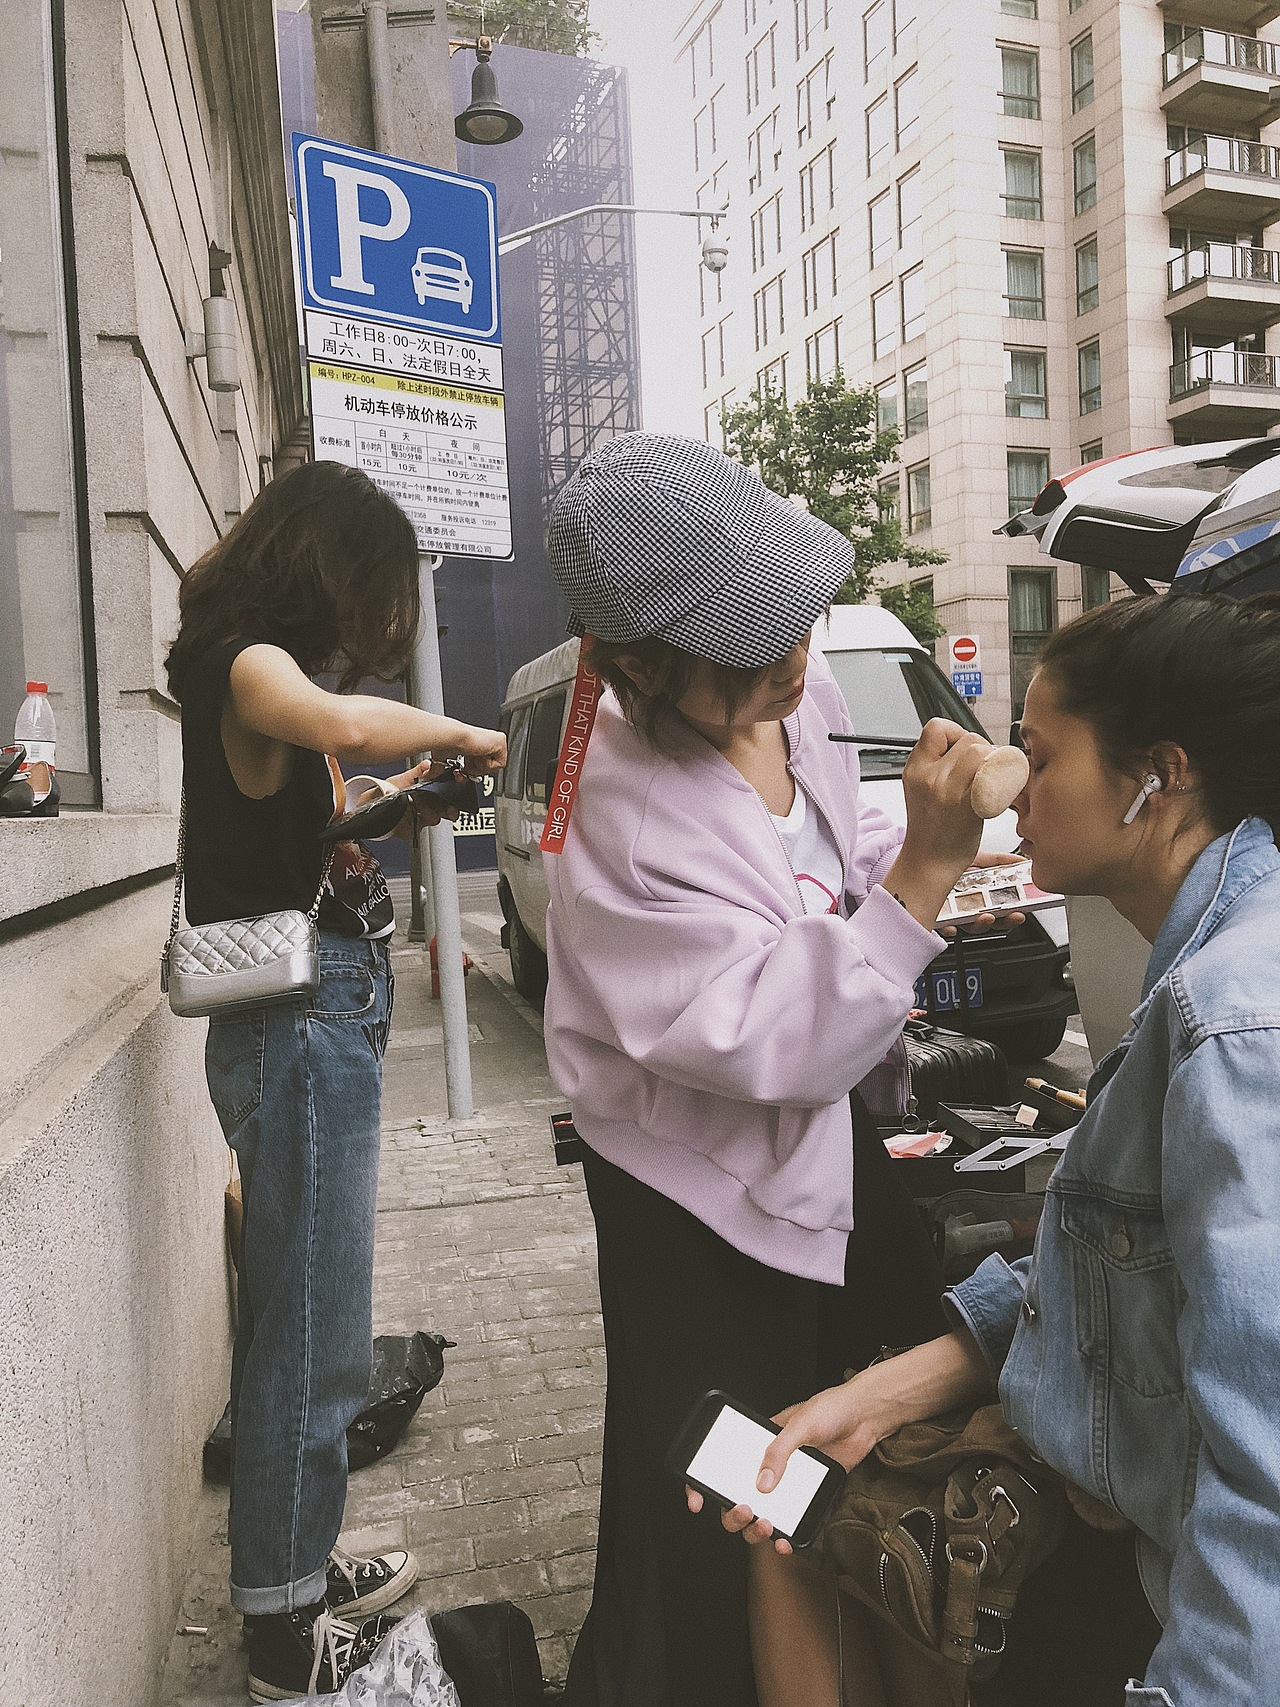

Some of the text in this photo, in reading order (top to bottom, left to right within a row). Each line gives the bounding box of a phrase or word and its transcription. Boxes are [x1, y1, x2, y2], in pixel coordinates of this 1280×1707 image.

[322, 160, 411, 296] P
[322, 338, 491, 383] 周六、日、法定假日全天
[342, 371, 376, 385] HPZ-004
[397, 380, 499, 407] 除上述时段外禁止停放车辆
[344, 394, 478, 431] 机动车停放价格公示
[319, 435, 351, 448] 收费标准
[362, 458, 382, 468] 15元
[391, 450, 422, 460] 每30分钟
[399, 463, 417, 473] 10元
[447, 470, 488, 483] 10元/次
[417, 525, 457, 537] 交通委员会
[419, 539, 492, 554] 车停放管理有限公司
[572, 691, 595, 735] THAT
[562, 734, 585, 776] KIND
[558, 778, 574, 805] OF
[546, 805, 567, 842] GIRL
